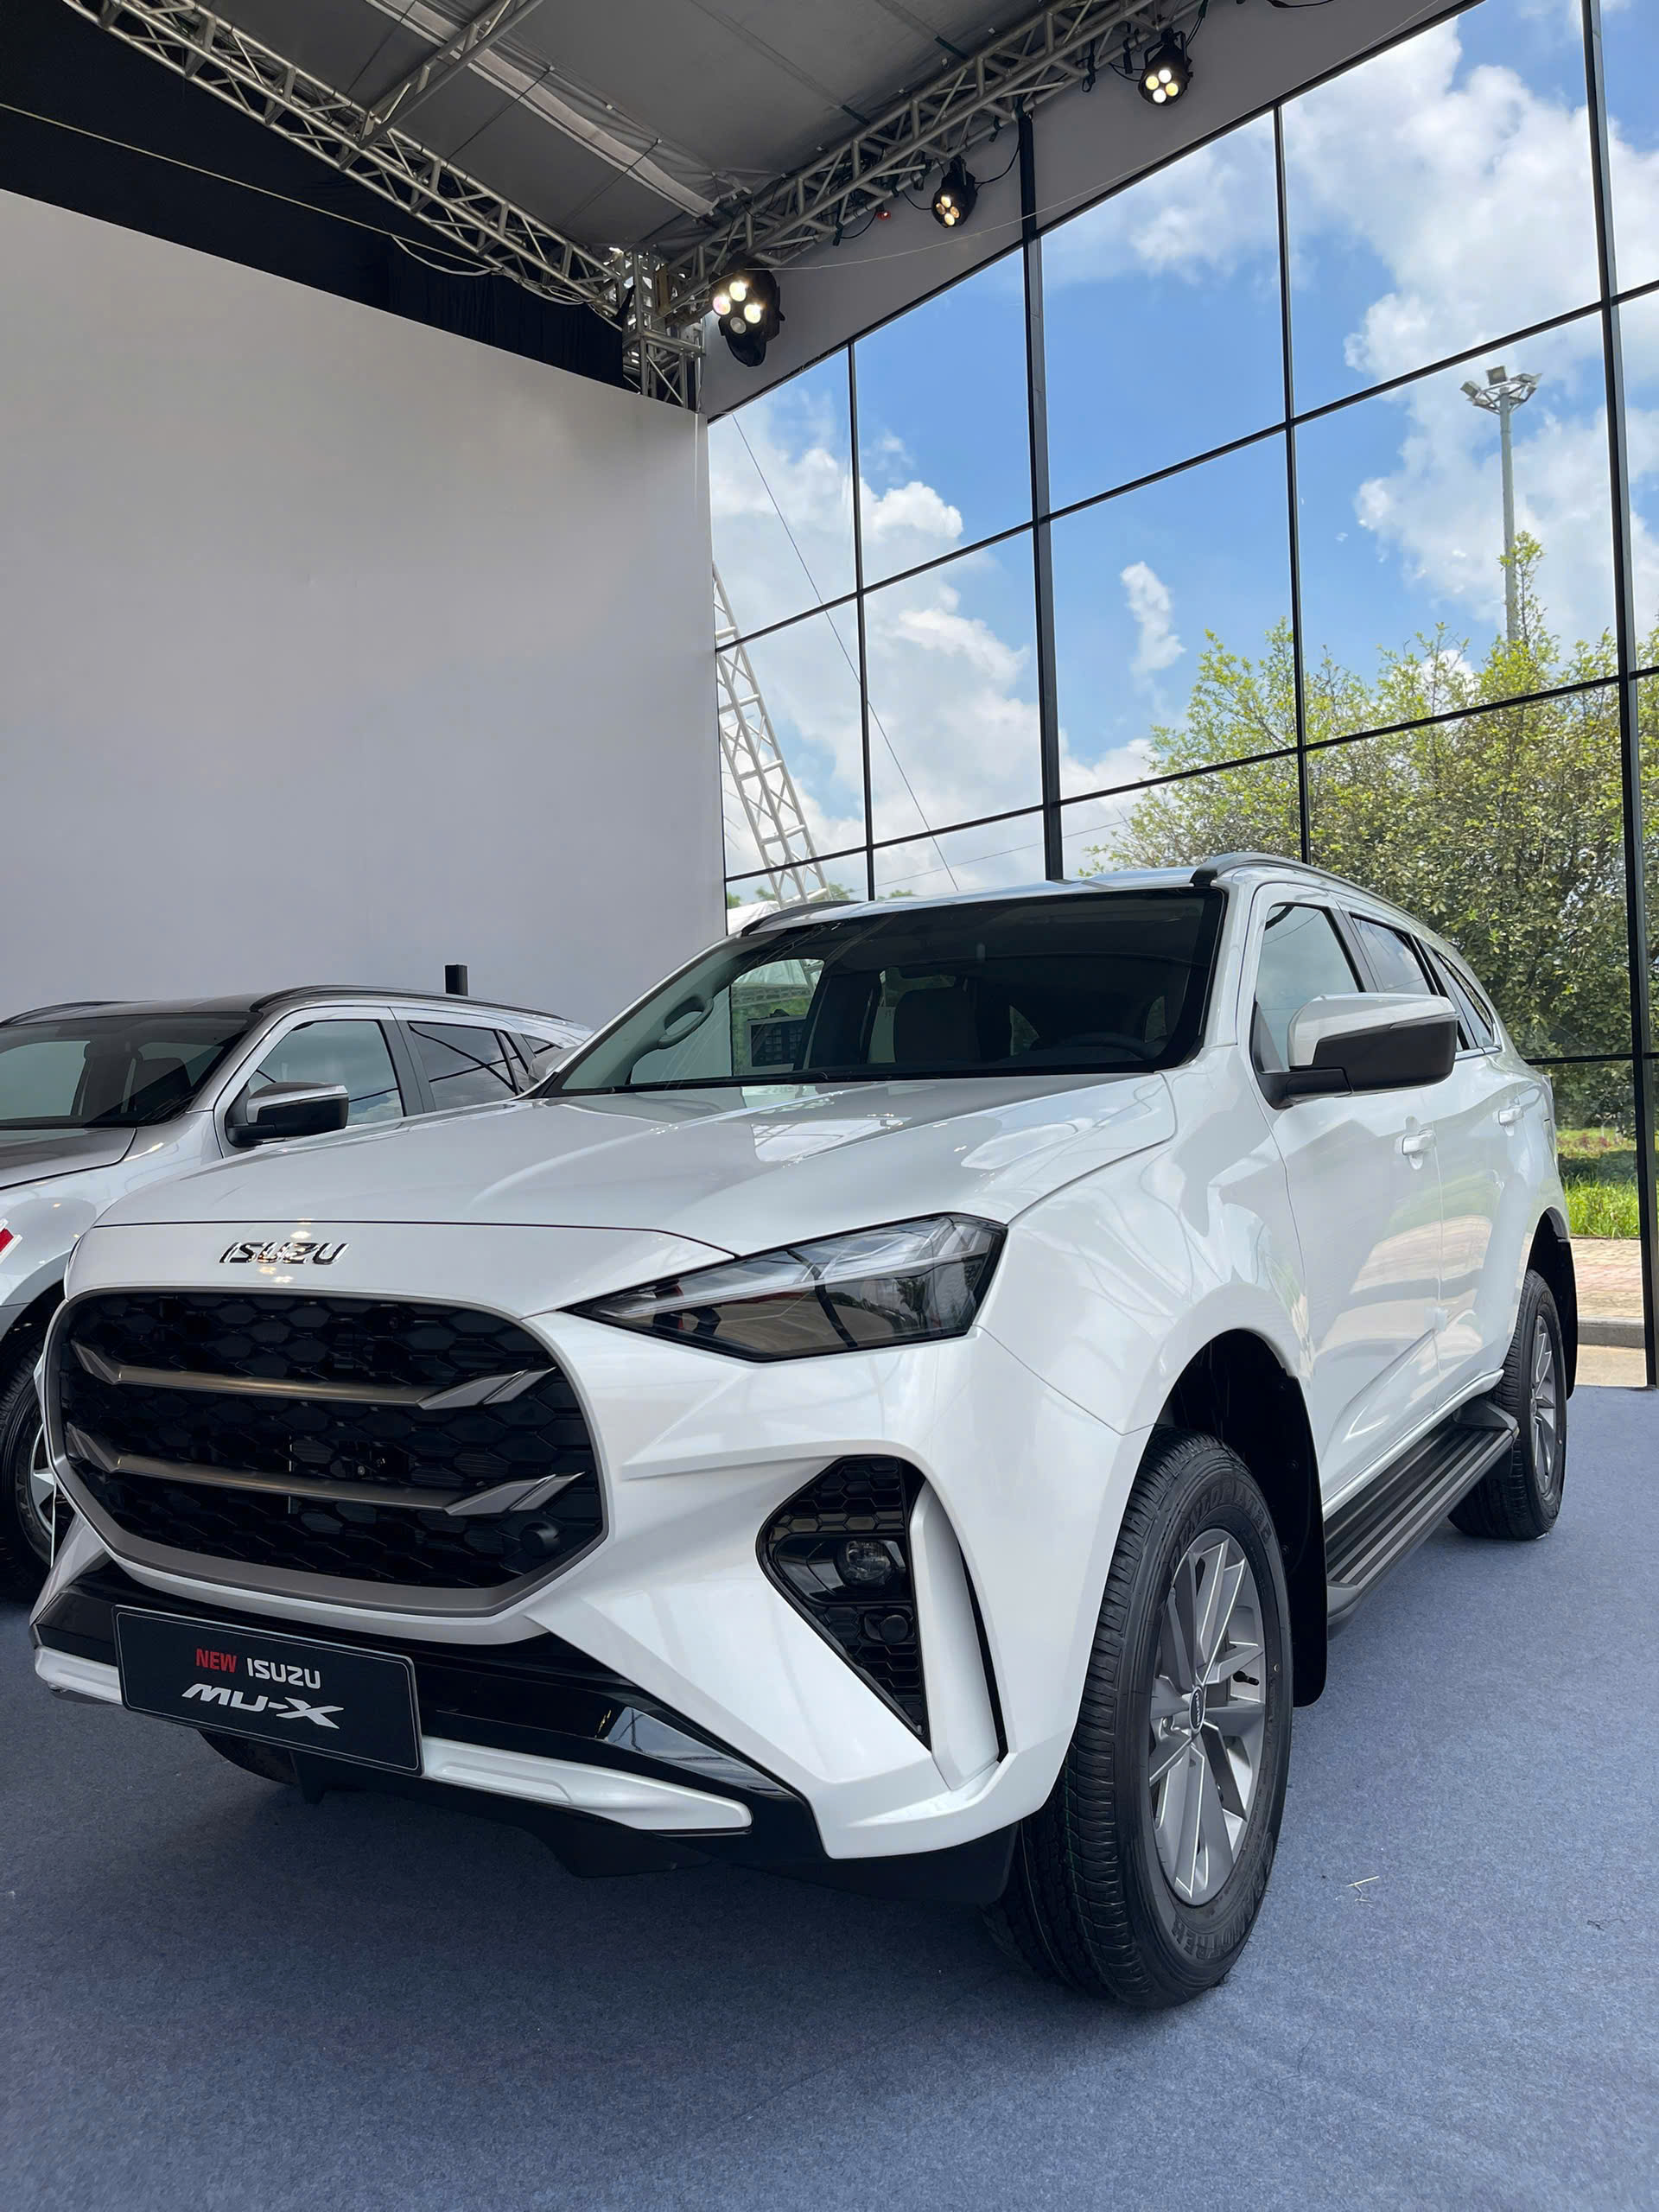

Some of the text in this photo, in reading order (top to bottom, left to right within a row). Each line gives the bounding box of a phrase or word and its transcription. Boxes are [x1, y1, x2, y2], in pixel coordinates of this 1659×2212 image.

[219, 1242, 349, 1265] ISUZU
[195, 1649, 321, 1689] NEW ISUZU
